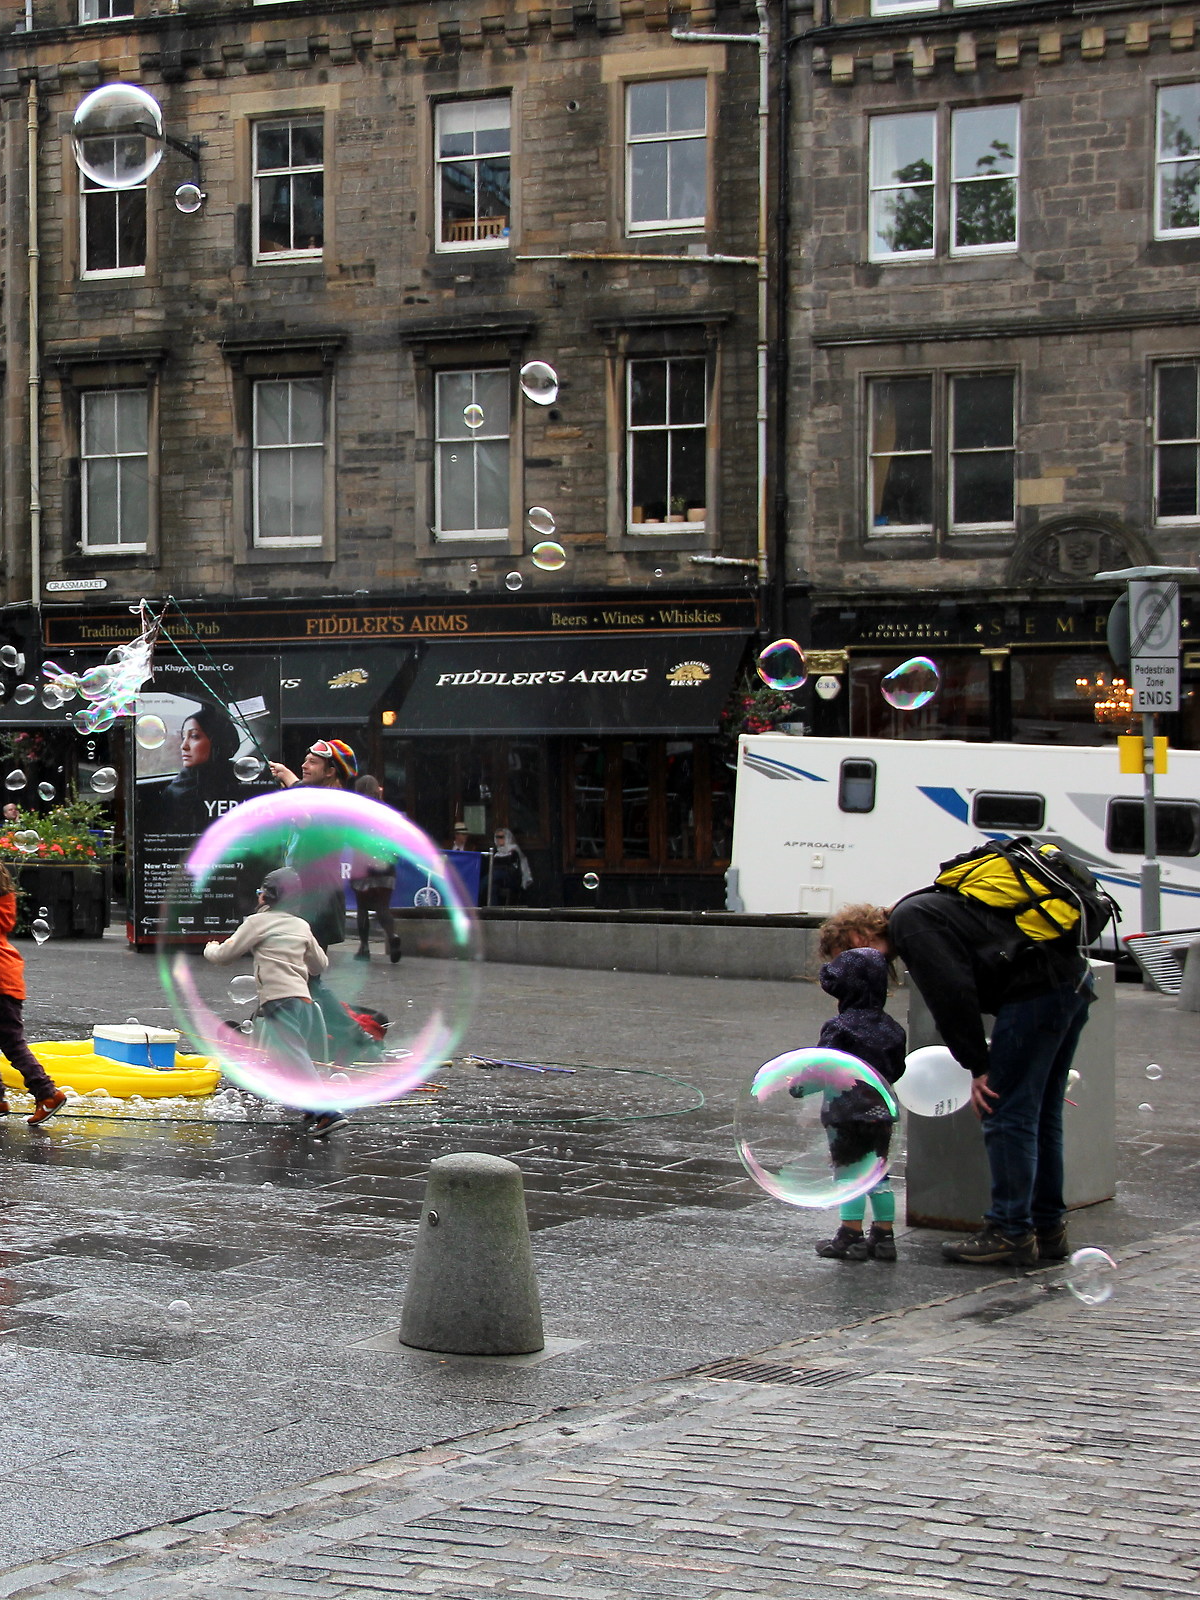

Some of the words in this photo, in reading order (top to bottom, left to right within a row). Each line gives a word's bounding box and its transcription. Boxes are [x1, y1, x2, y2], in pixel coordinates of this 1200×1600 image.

[49, 579, 103, 590] GRASSMARKET
[551, 612, 587, 626] Beers
[602, 611, 644, 624] Wines
[659, 609, 721, 623] Whiskies
[79, 625, 143, 638] Traditional
[197, 621, 220, 634] Pub
[306, 615, 404, 634] FIDDLER'S
[409, 615, 468, 632] ARMS
[877, 623, 909, 631] ONLY
[990, 616, 1108, 636] SEMP
[859, 630, 949, 639] APPOINTMENT
[198, 663, 221, 671] Dance
[222, 663, 234, 671] Co
[1135, 664, 1175, 674] Pedestrian
[435, 669, 566, 686] FIDDLER'S
[568, 668, 648, 684] ARMS
[1146, 677, 1164, 687] Zone
[1138, 691, 1172, 705] ENDS
[784, 841, 845, 849] APPROACH
